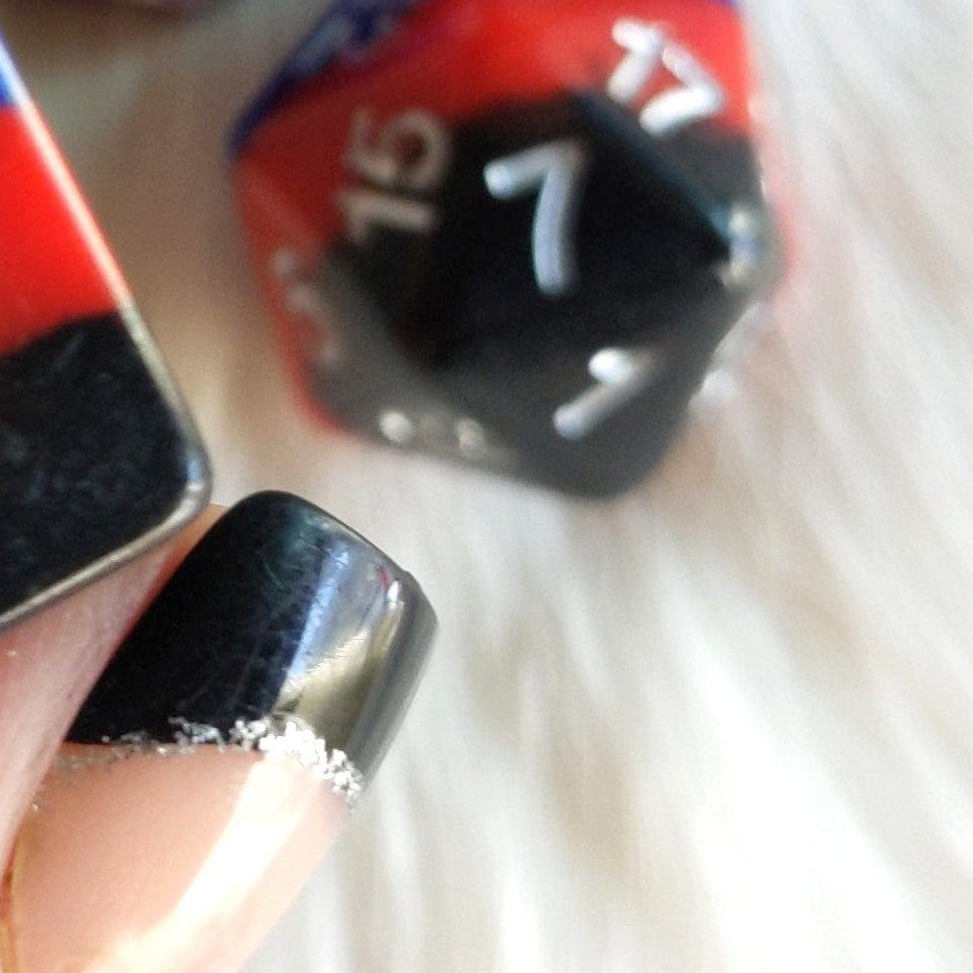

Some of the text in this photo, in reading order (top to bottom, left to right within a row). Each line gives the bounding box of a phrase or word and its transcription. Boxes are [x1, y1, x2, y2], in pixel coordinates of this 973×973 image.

[609, 17, 723, 137] 17
[339, 107, 453, 247] 15
[483, 135, 593, 297] 7
